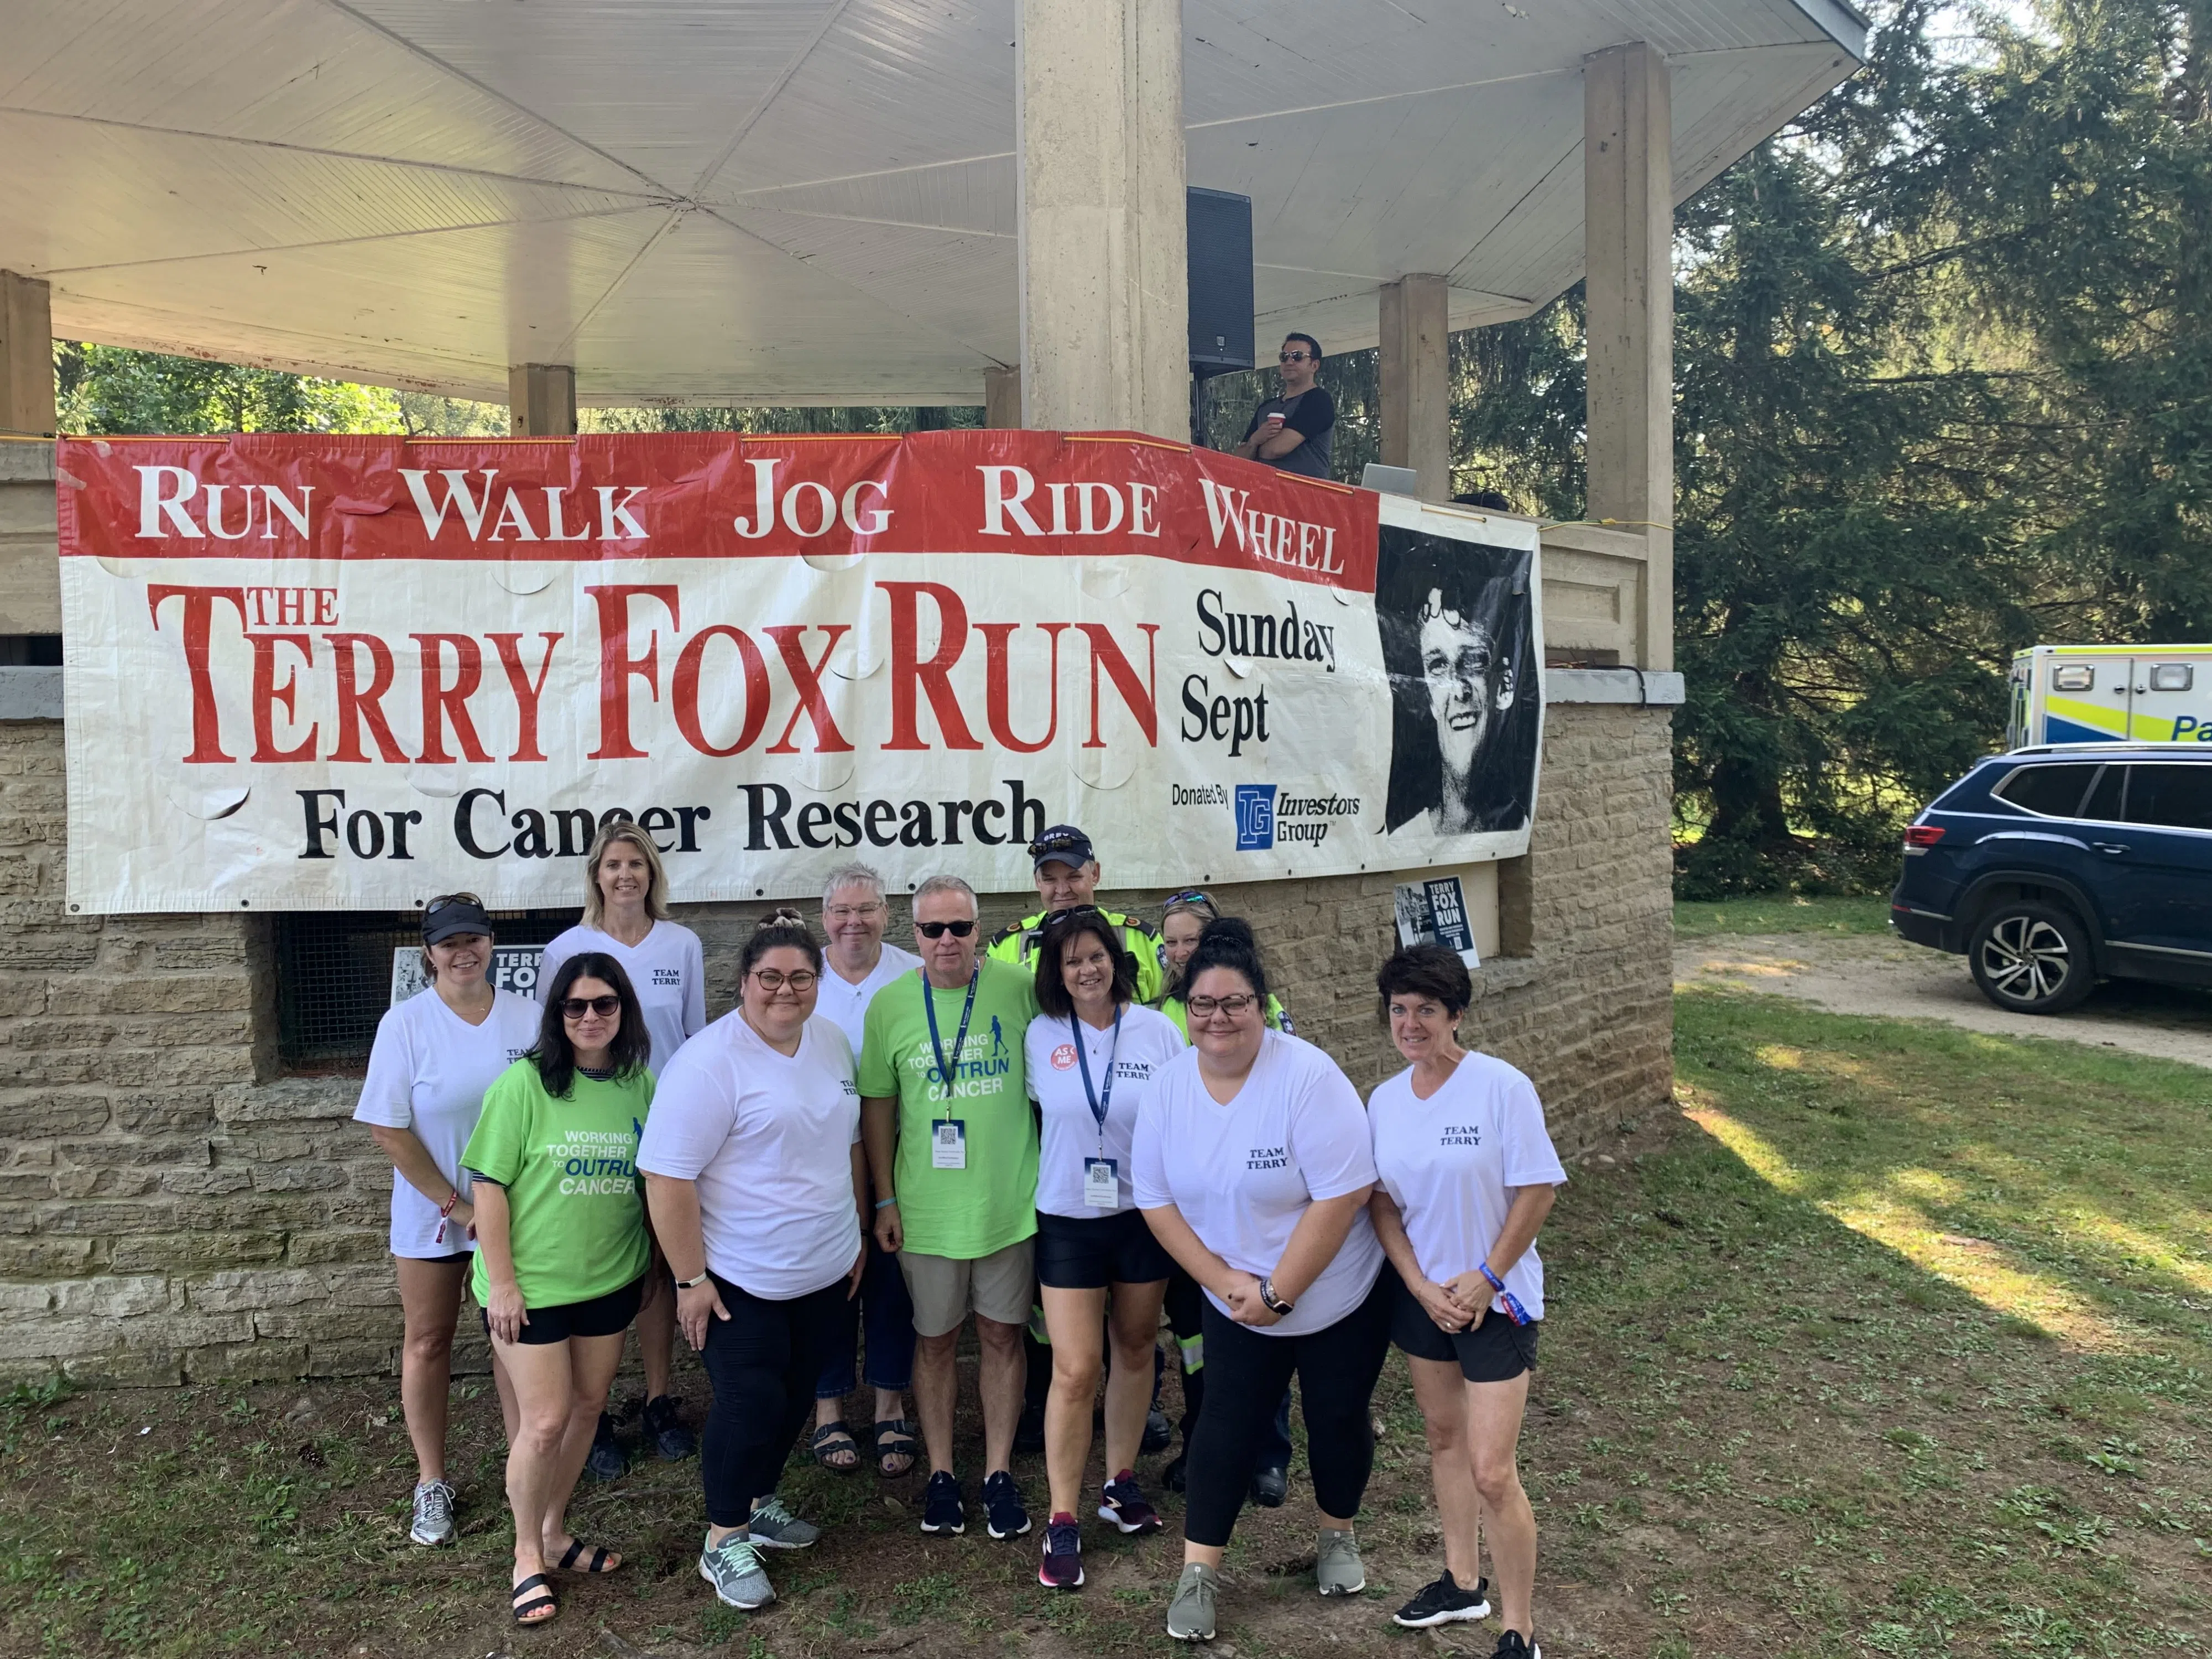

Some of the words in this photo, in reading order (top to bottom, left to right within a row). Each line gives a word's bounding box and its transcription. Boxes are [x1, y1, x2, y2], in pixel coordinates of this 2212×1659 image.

[132, 465, 316, 540] RUN
[397, 468, 650, 541] WALK
[734, 458, 894, 539] JOG
[975, 465, 1161, 538] RIDE
[1198, 478, 1345, 575] WHEEL
[247, 587, 340, 626] THE
[1196, 589, 1334, 672] Sunday
[148, 583, 564, 764] TERRY
[585, 585, 855, 759] FOX
[875, 581, 1160, 753] RUN
[1182, 674, 1270, 757] Sept
[1172, 784, 1215, 806] Donated
[1215, 784, 1229, 810] By
[1277, 793, 1360, 816] Investors
[296, 789, 422, 859] For
[737, 780, 1045, 851] Research
[1277, 821, 1328, 847] Group
[1429, 881, 1454, 895] TERRY
[1432, 891, 1459, 910] FOX
[1436, 908, 1461, 926] RUN
[495, 967, 536, 988] FO
[1057, 1056, 1071, 1064] ME
[1119, 1062, 1149, 1072] TEAM
[927, 1057, 1009, 1083] OTRUN
[1116, 1071, 1150, 1081] TERRY
[928, 1078, 1003, 1102] CANCER
[565, 1130, 633, 1144] WORKING
[1444, 1126, 1479, 1135] TEAM
[1440, 1136, 1481, 1145] TERRY
[546, 1144, 627, 1158] TOGETHER
[1250, 1147, 1284, 1158] TEAM
[566, 1158, 638, 1177] OUTRU
[1246, 1157, 1288, 1169] TERRY
[559, 1178, 635, 1195] CANCER
